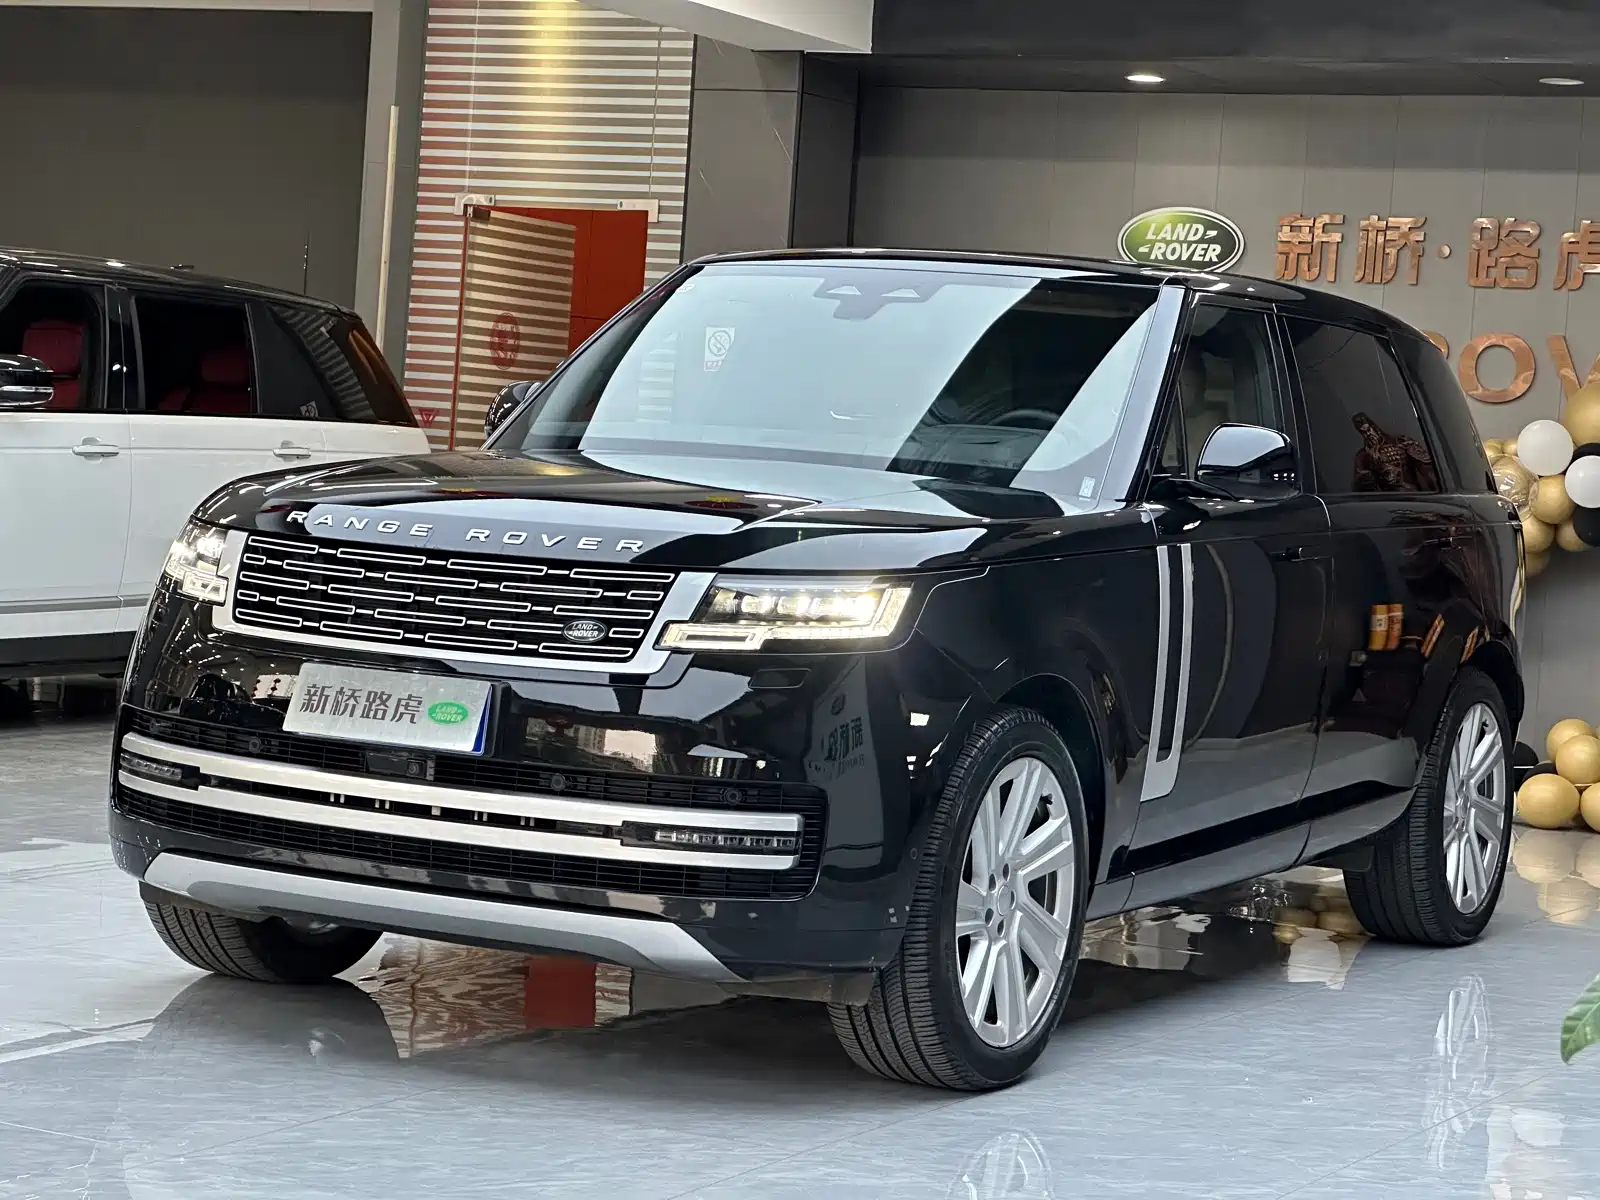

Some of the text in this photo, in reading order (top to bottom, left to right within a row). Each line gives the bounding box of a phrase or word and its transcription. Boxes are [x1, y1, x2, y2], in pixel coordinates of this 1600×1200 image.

[1145, 223, 1204, 241] LAND
[1151, 242, 1221, 262] ROVER
[1420, 330, 1600, 403] OV
[286, 510, 643, 553] RANGE ROVER
[299, 684, 423, 725] 新桥路虎
[436, 704, 457, 713] LAND
[435, 712, 463, 721] ROVER
